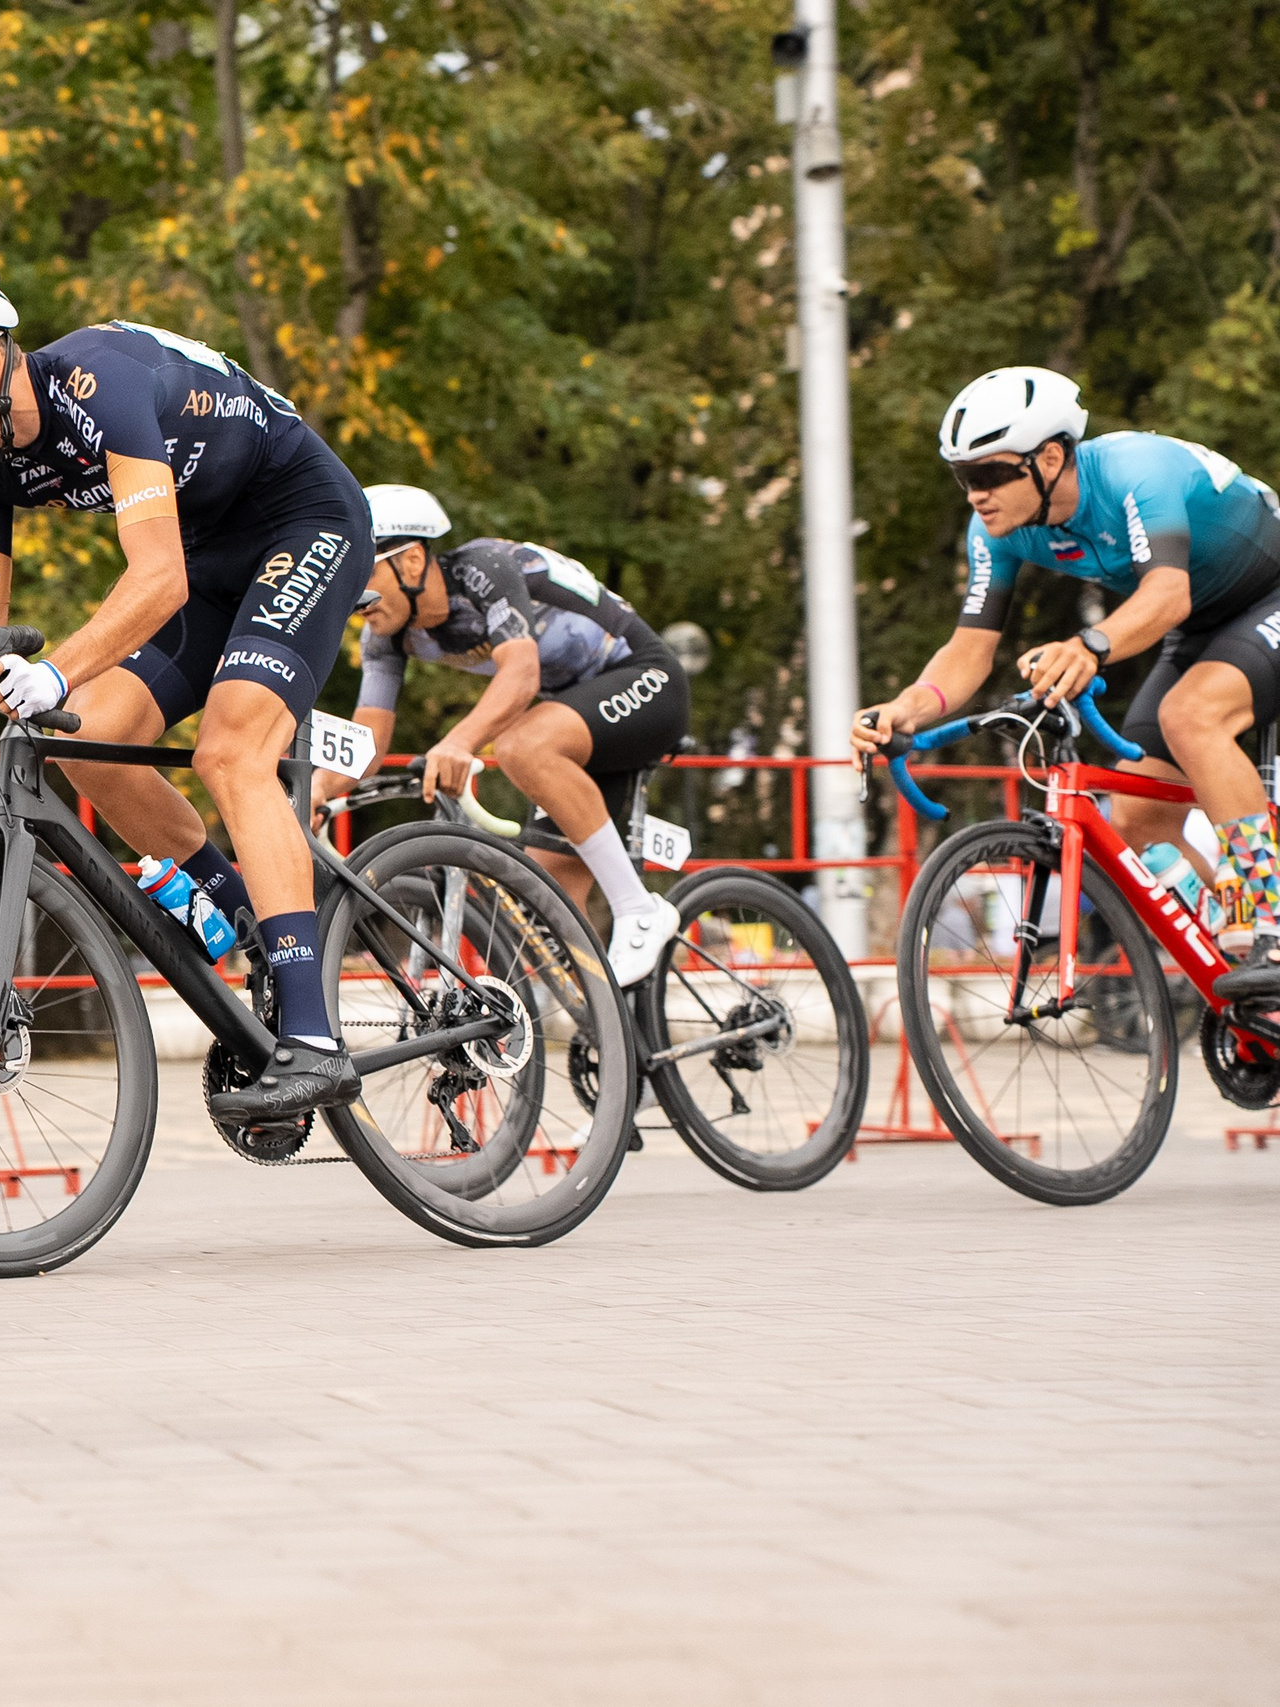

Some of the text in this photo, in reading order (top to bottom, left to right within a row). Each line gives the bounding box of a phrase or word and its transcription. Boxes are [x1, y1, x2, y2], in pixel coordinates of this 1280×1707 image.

[251, 531, 343, 631] Капитал
[284, 539, 352, 636] УПРАВЛЕНИЕ АКТИВАМИ
[962, 535, 993, 614] MAIKOP
[225, 650, 296, 683] дикси
[598, 667, 670, 724] COUCOU
[322, 730, 354, 767] 55
[348, 725, 368, 737] РСХБ
[653, 833, 675, 860] 68
